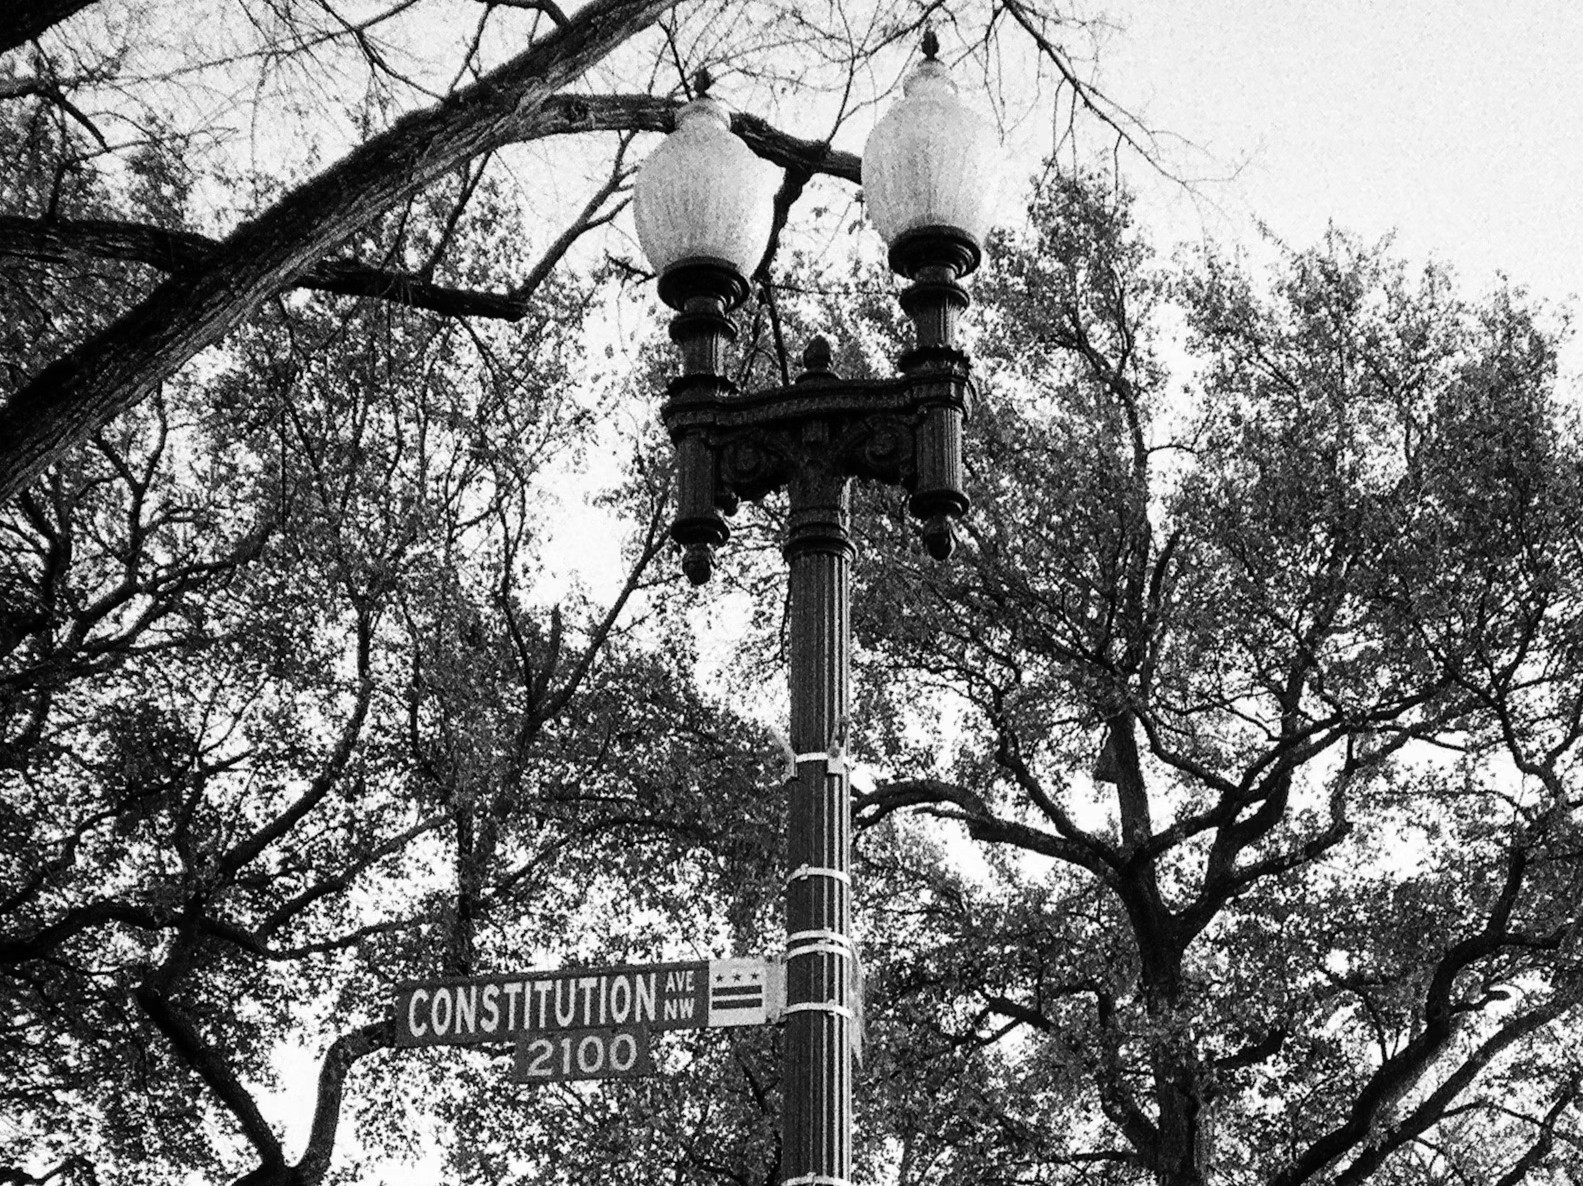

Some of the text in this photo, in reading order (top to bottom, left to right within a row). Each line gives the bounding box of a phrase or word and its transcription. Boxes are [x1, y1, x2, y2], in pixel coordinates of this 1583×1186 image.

[408, 970, 695, 1038] CONSTITUTION AVE
[664, 997, 695, 1020] NW
[526, 1033, 637, 1077] 2100
